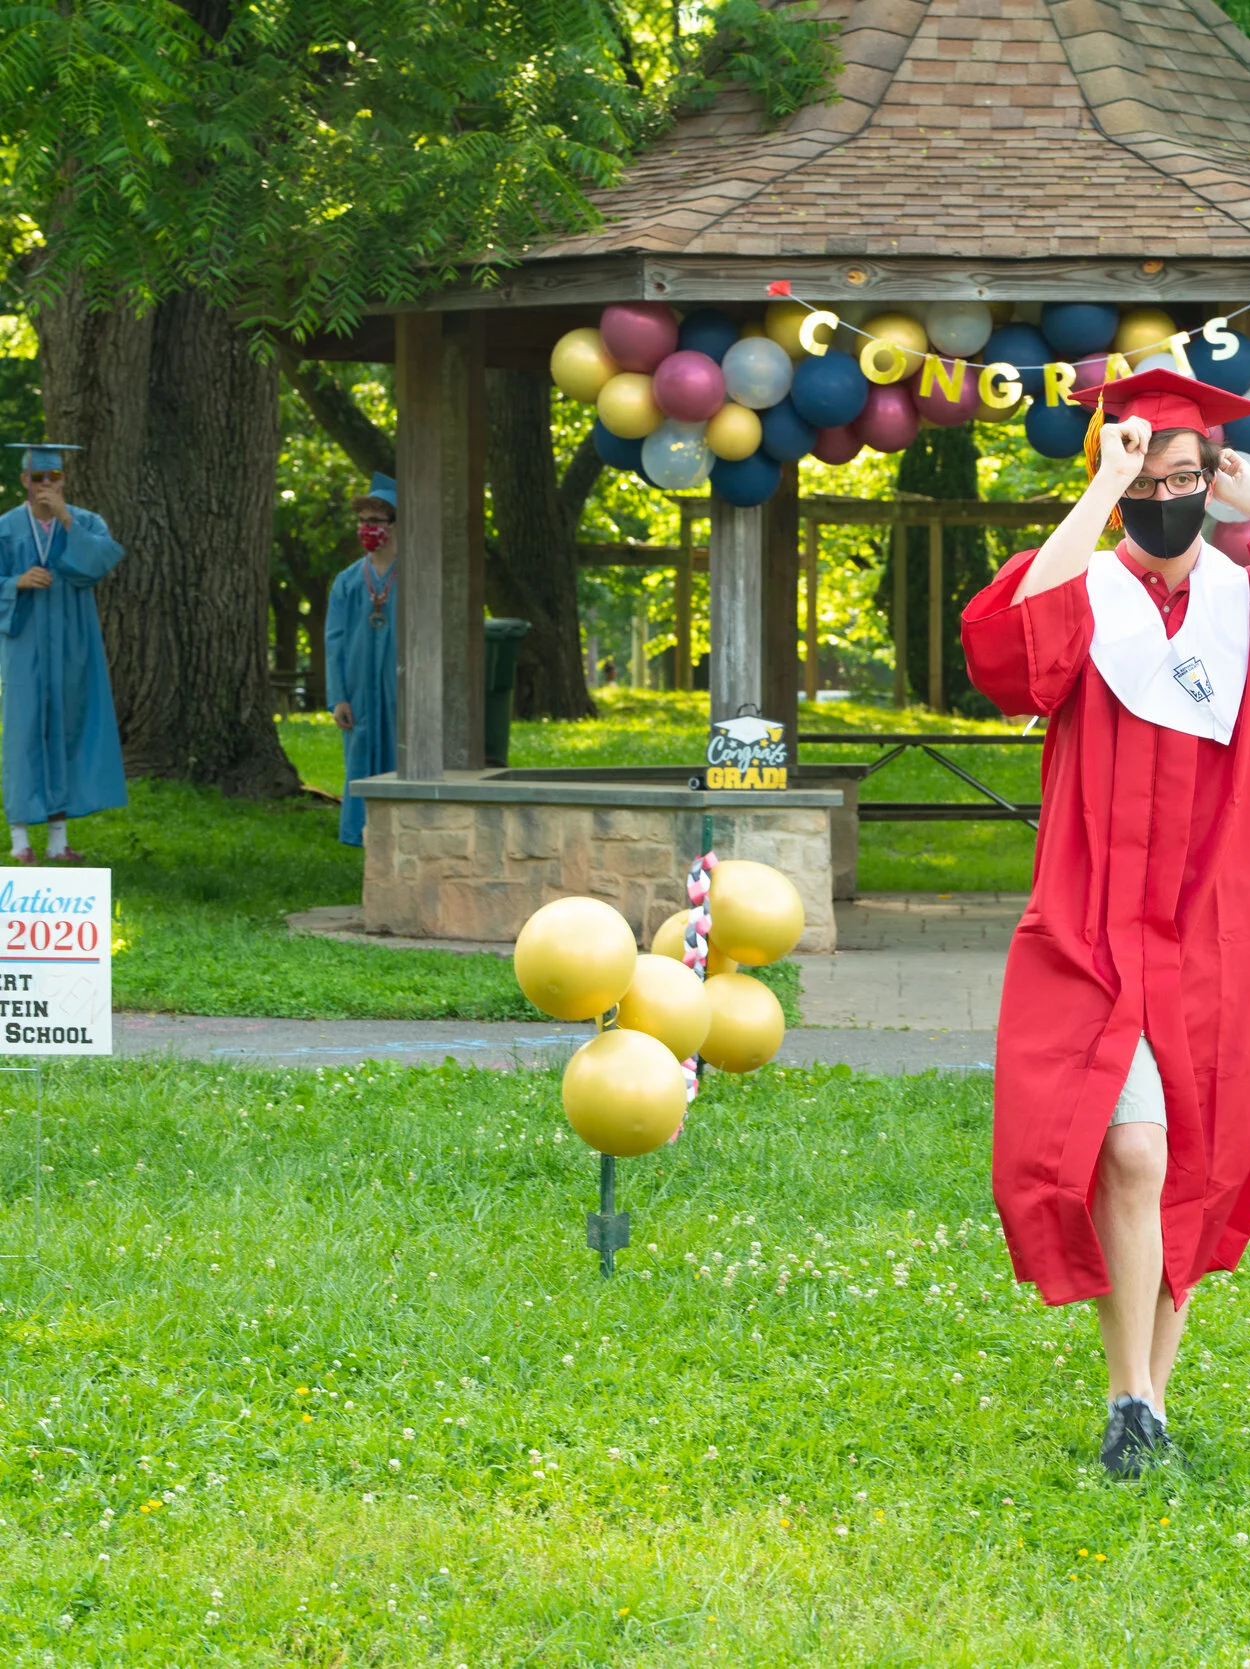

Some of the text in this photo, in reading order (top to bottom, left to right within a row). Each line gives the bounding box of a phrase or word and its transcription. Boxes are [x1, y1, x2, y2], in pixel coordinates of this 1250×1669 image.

[799, 311, 1240, 407] CONGRATS
[707, 735, 788, 773] Congrats
[706, 767, 788, 790] GRAD!
[6, 920, 98, 951] 2020
[0, 974, 33, 991] RT
